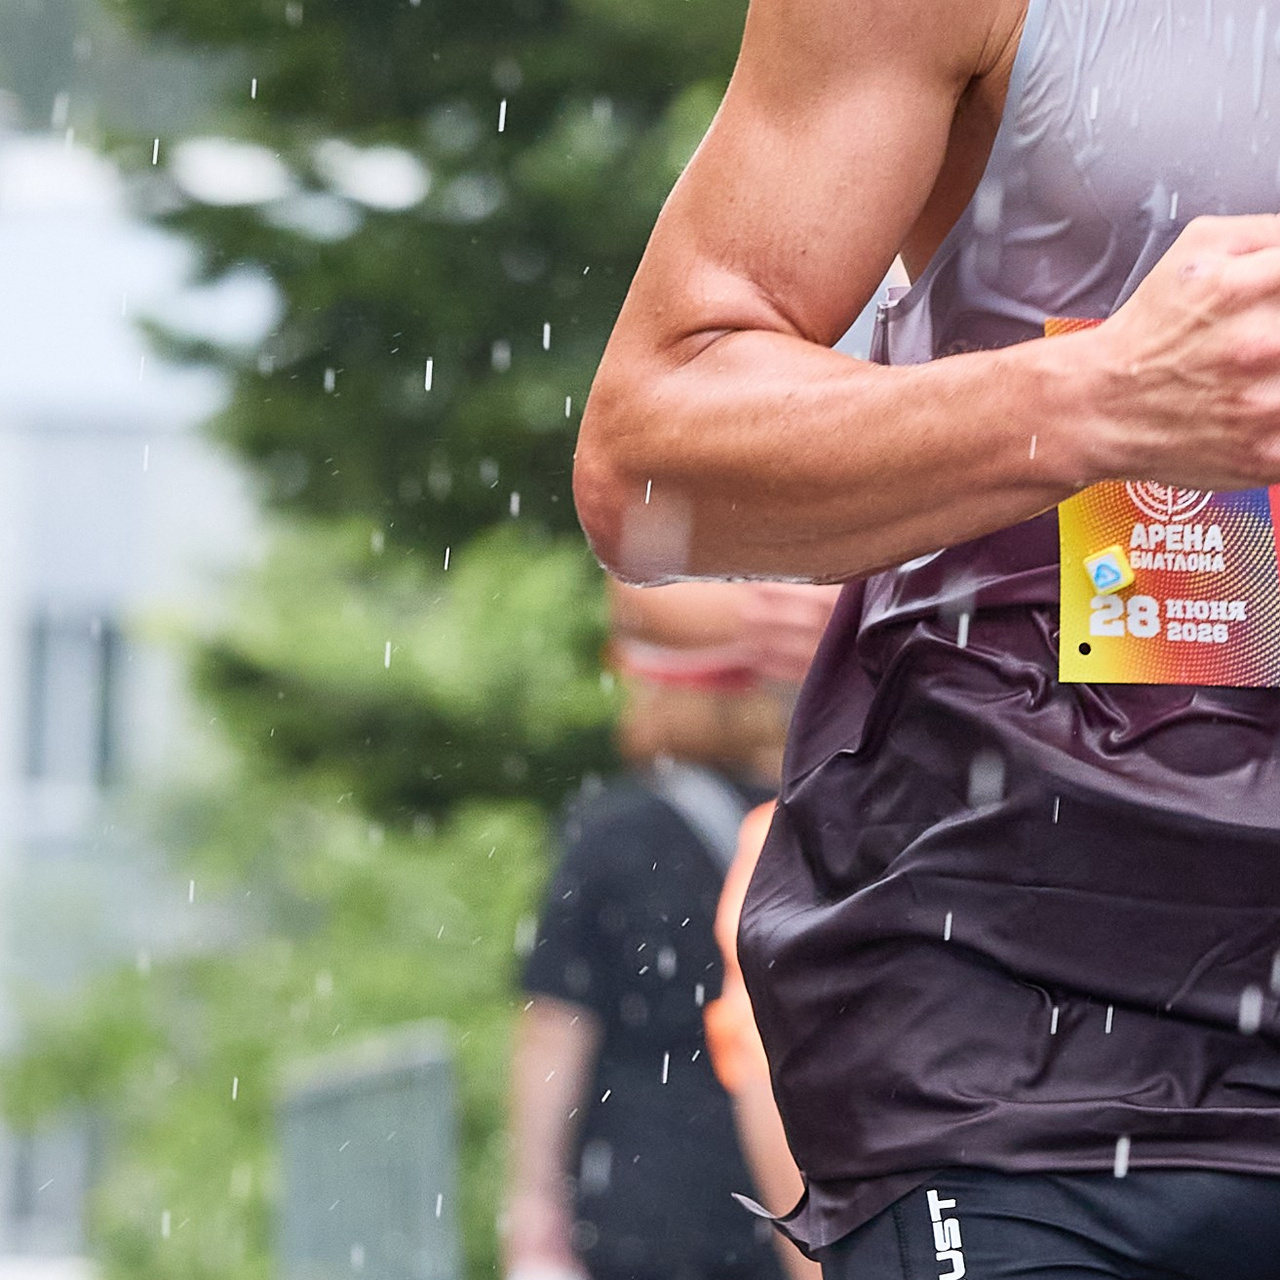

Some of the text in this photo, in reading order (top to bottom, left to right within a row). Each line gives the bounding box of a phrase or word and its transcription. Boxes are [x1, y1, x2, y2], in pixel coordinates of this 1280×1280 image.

[1130, 523, 1224, 552] АРЕНА
[1130, 551, 1226, 573] БИАТЛОНА
[1090, 594, 1248, 638] 28 ИЮНЯ
[1167, 622, 1229, 643] 2026
